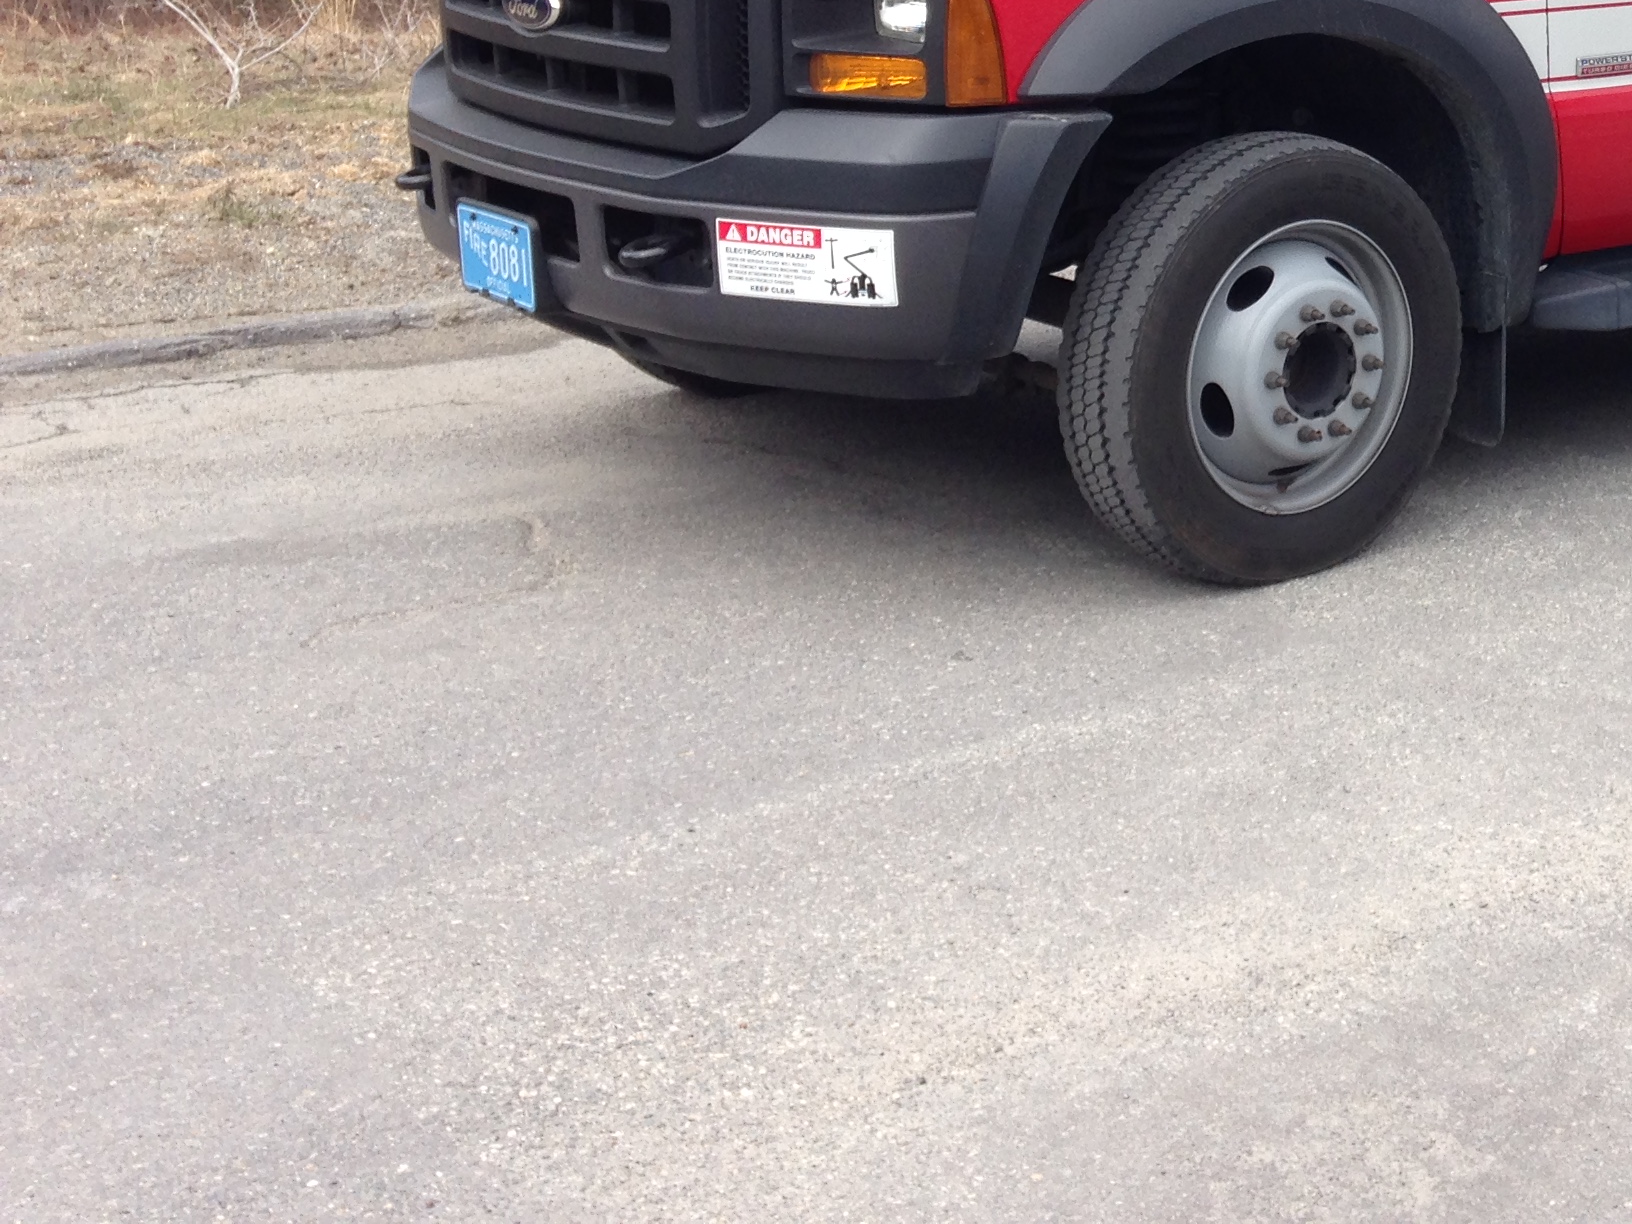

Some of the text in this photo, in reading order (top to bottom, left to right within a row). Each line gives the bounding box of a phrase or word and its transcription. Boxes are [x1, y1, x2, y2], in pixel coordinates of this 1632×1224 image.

[746, 225, 814, 246] DANGER
[463, 220, 527, 287] FIRE 8081
[725, 247, 815, 260] ELECTROCUTION HAZARD
[750, 285, 795, 295] KEEP CLEAR
